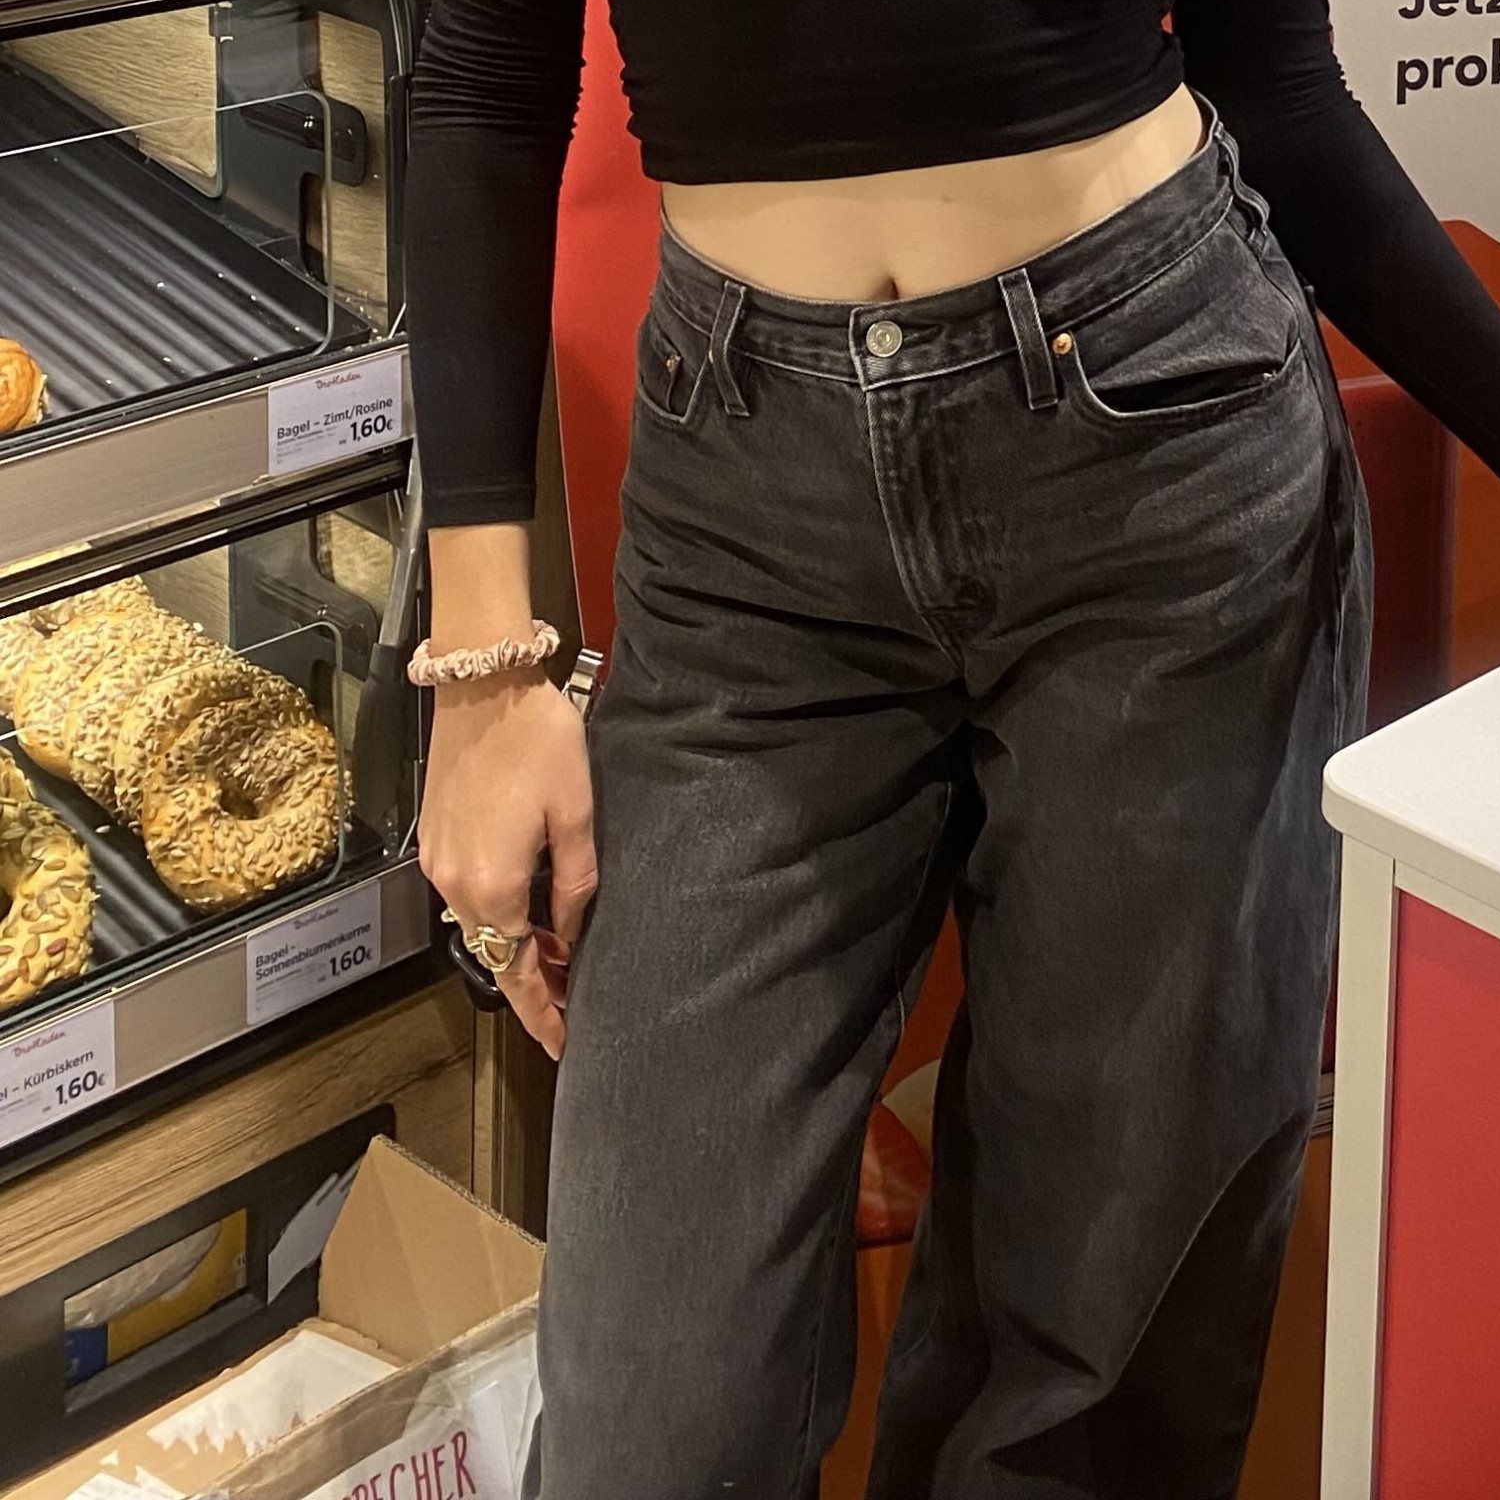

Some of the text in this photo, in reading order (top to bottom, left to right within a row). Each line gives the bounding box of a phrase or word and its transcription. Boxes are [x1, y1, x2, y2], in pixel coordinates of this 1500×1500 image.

[276, 419, 310, 440] Bagel
[323, 397, 394, 427] Zimt/Rosine
[255, 922, 372, 981] Sonnenblumenkerne
[255, 942, 289, 969] Bagel
[24, 1051, 94, 1090] Kürbiskern
